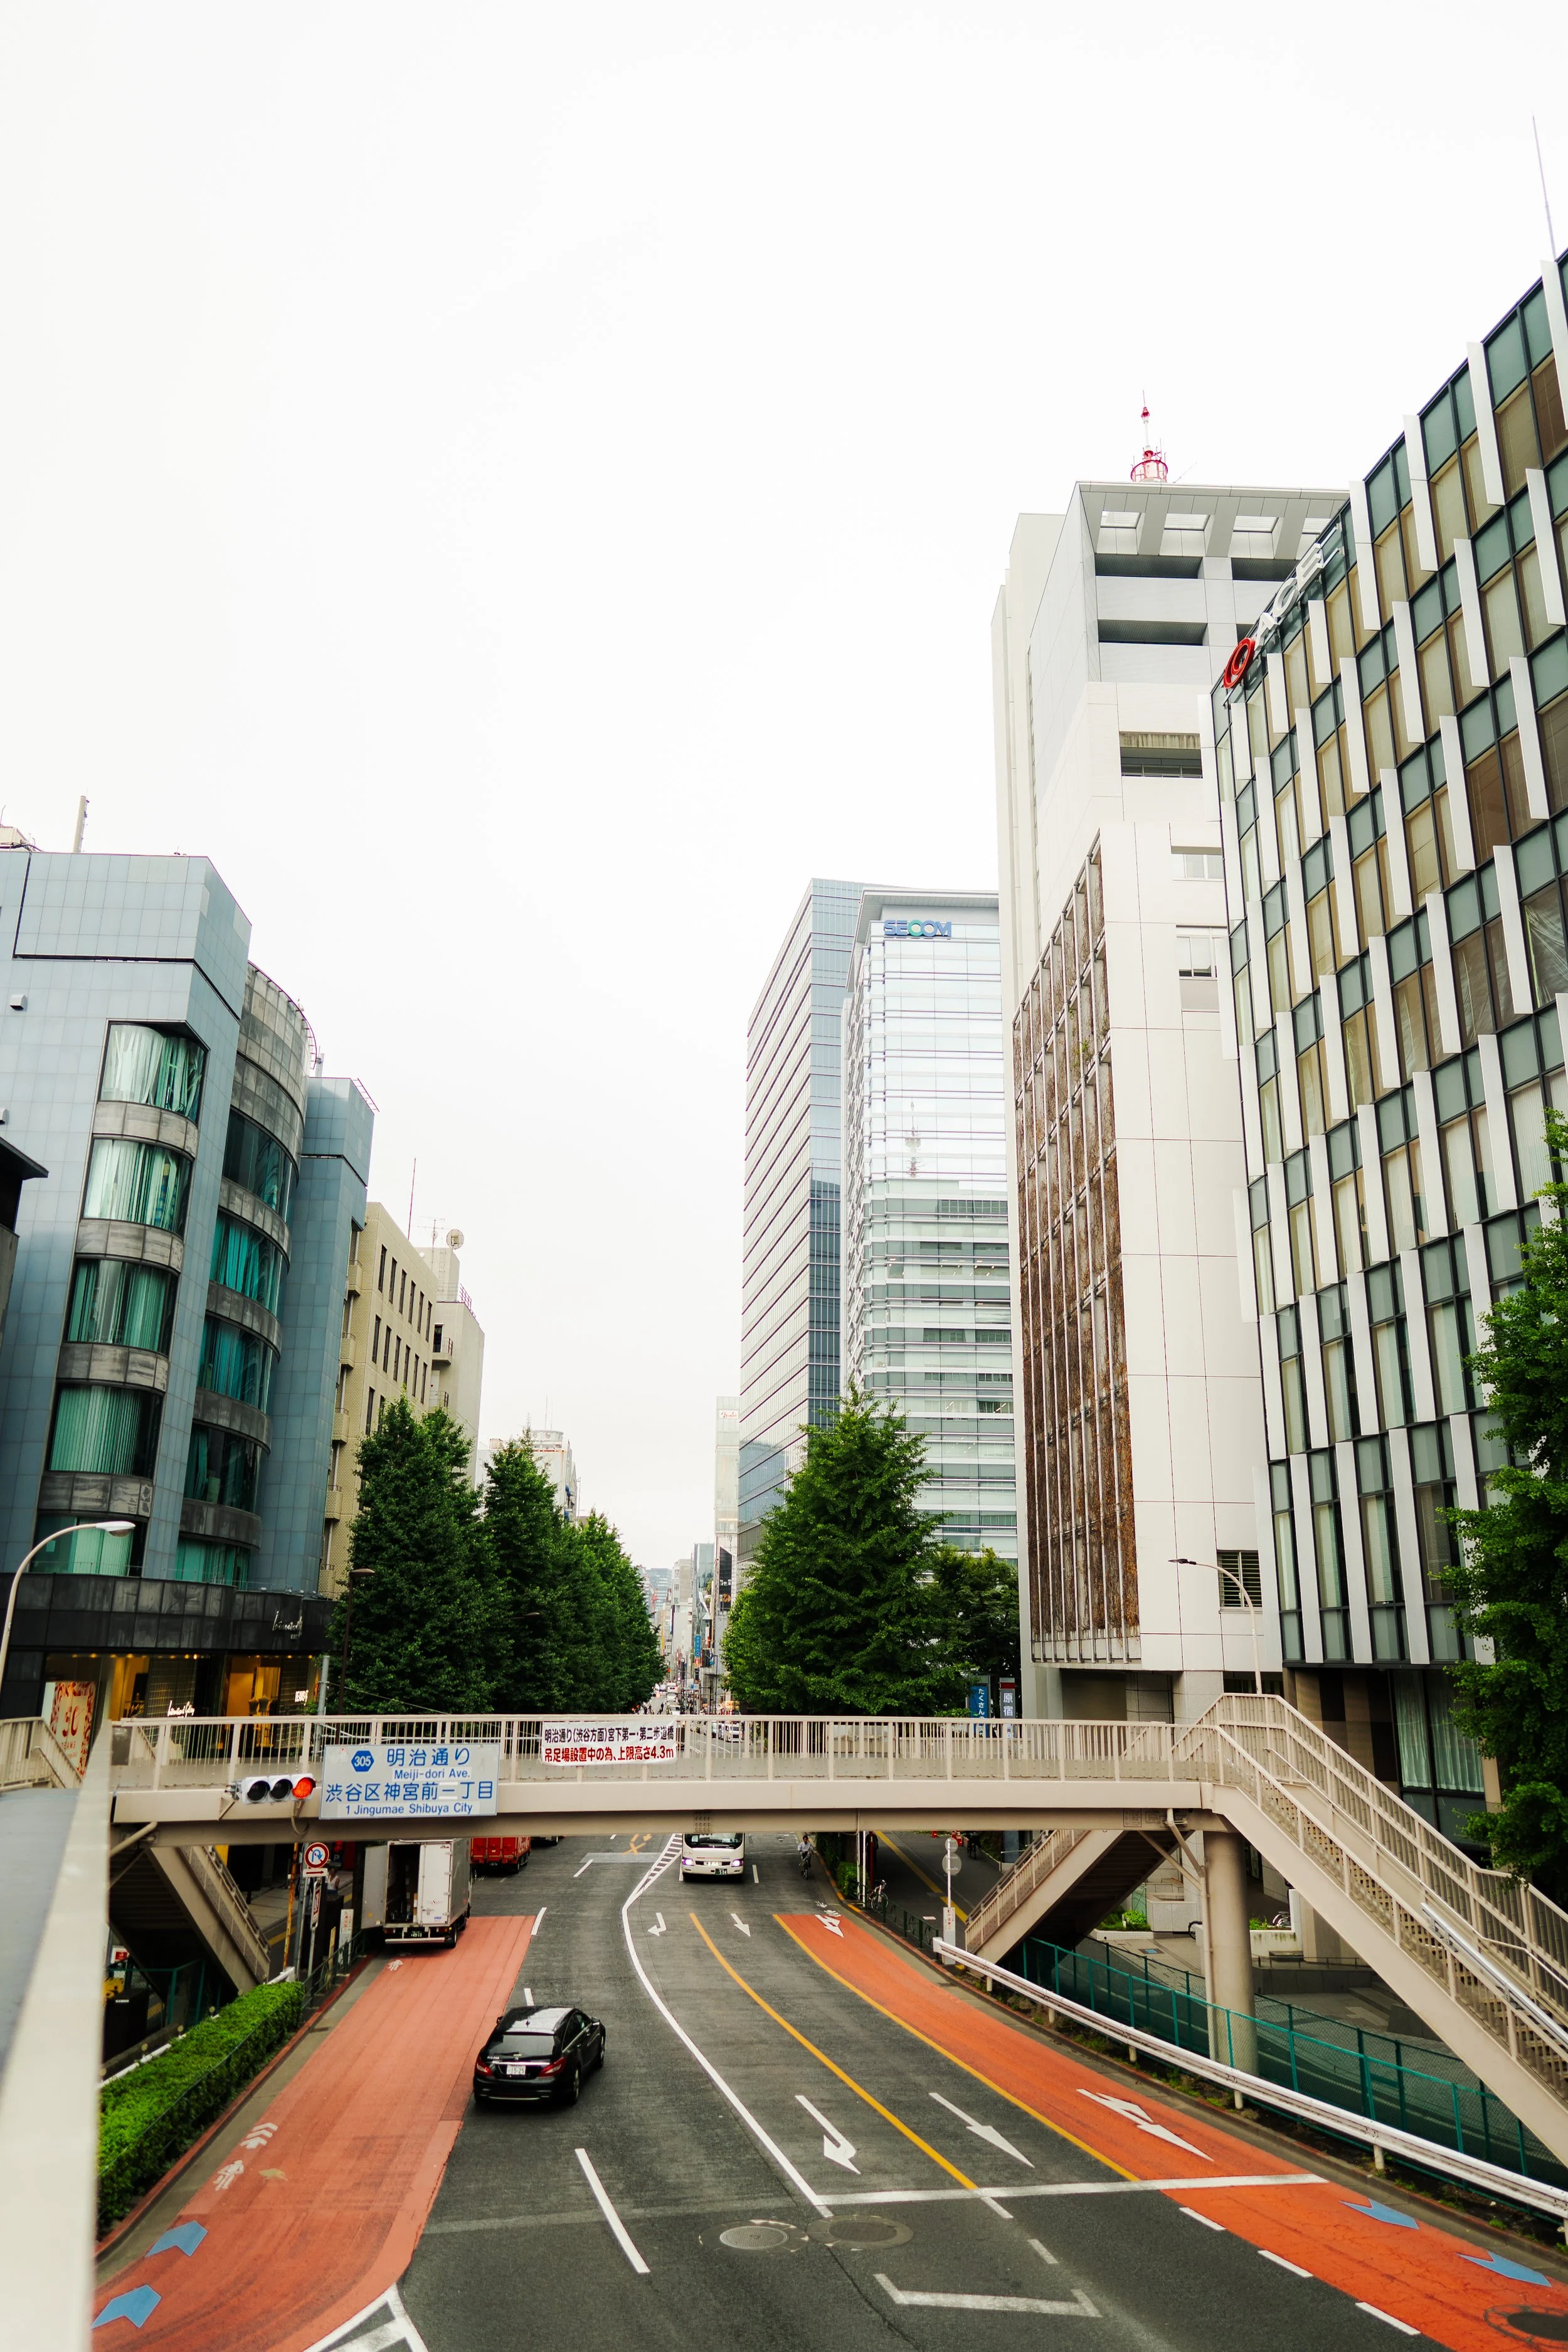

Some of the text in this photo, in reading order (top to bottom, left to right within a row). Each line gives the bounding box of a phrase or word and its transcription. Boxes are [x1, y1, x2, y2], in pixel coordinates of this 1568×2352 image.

[884, 919, 951, 937] SECOM
[354, 1756, 371, 1767] 305
[387, 1747, 470, 1767] 明治通り
[394, 1768, 470, 1781] Meiji-dori Ave.
[326, 1781, 492, 1802] 渋谷区神宮前一丁目
[346, 1803, 473, 1816] 1 Jingumae Shibuya City
